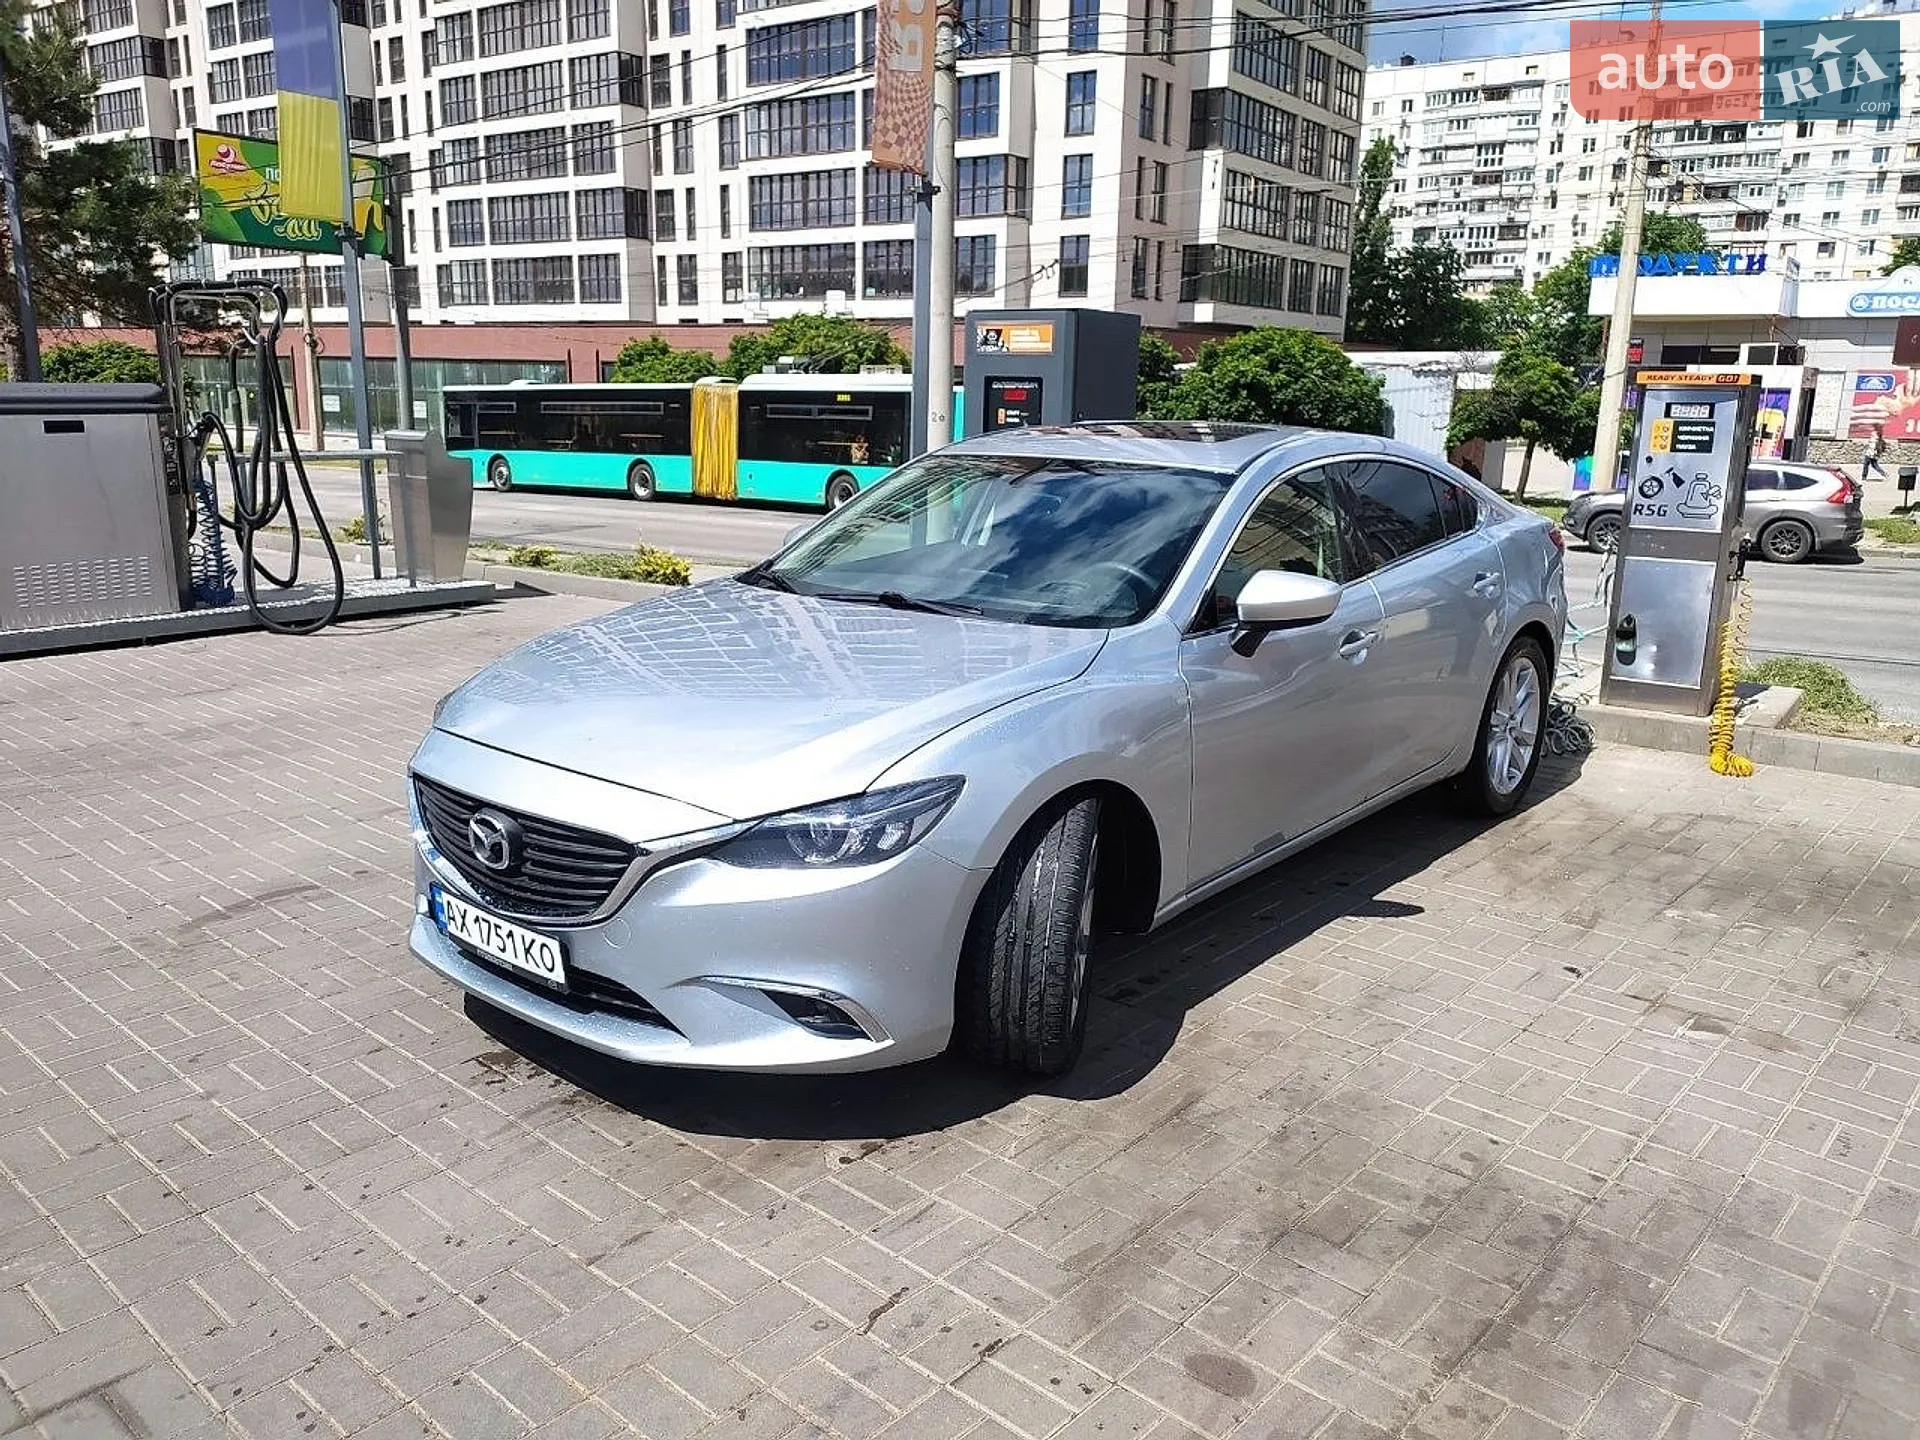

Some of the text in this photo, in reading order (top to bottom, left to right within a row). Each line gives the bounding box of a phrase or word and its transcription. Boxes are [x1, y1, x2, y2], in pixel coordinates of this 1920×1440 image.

[1678, 374, 1714, 382] STEADY
[1717, 374, 1740, 383] GO!
[1633, 503, 1669, 517] RSG
[446, 900, 471, 938] AX
[473, 915, 518, 959] 1751
[521, 935, 555, 973] KO
